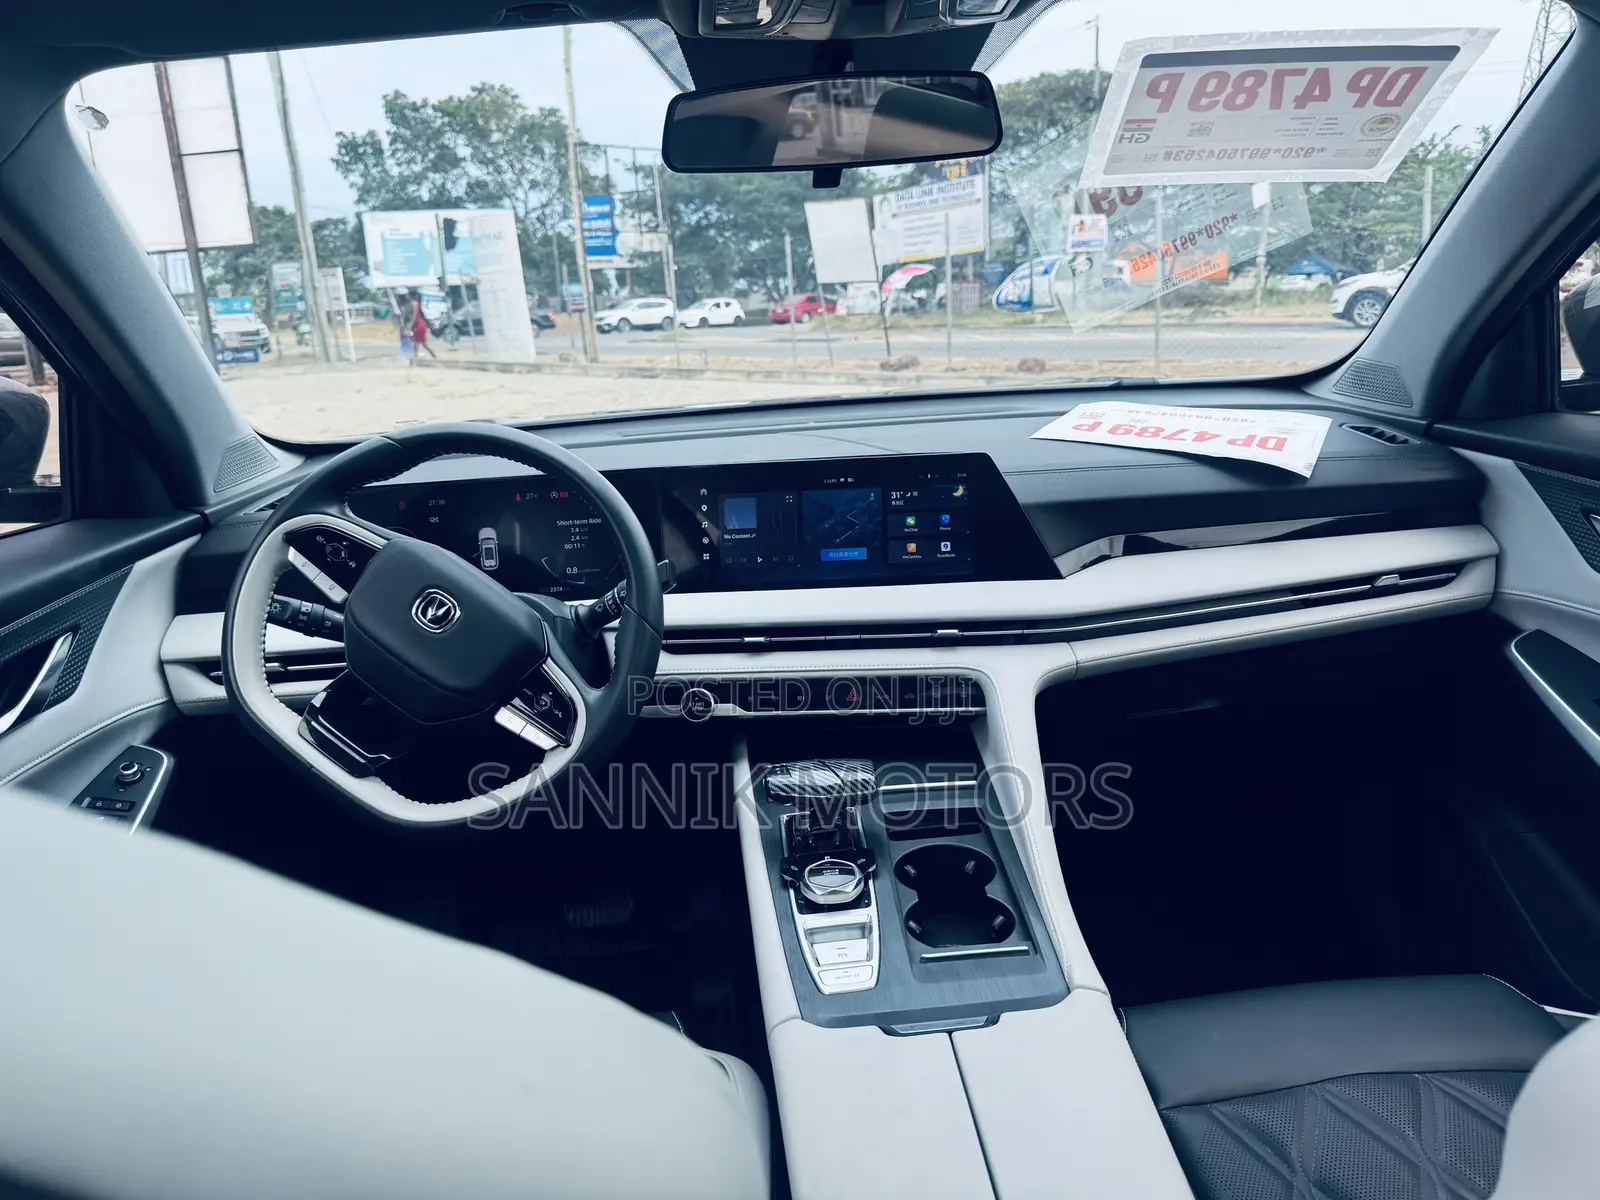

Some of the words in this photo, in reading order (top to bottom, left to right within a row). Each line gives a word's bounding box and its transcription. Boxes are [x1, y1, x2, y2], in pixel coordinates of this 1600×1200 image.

[1071, 421, 1104, 433] P
[1106, 424, 1223, 443] 4789
[1226, 435, 1288, 453] DP
[556, 519, 589, 527] Short-term
[566, 566, 579, 575] 0.8
